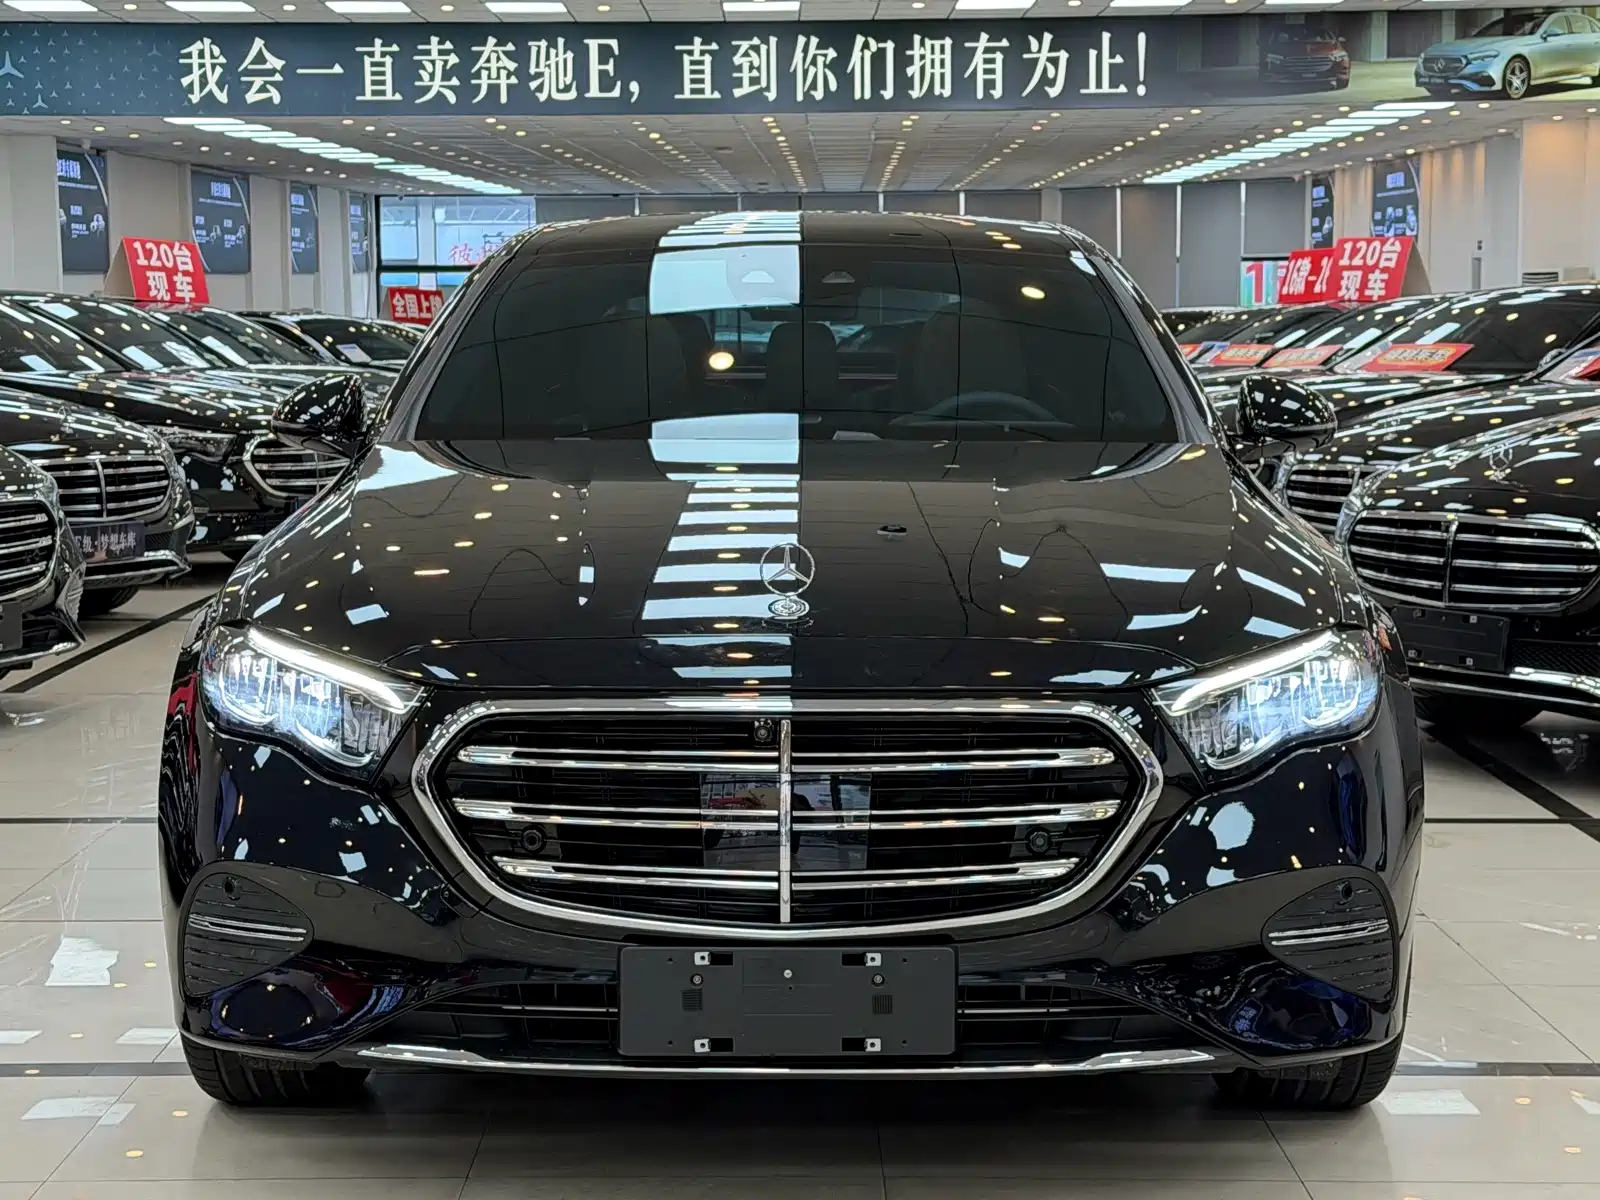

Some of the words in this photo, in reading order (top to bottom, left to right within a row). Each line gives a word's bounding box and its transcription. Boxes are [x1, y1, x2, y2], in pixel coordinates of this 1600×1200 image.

[133, 240, 194, 273] 120台
[1338, 237, 1402, 269] 120台
[145, 271, 196, 303] 现车
[1337, 269, 1389, 301] 现车
